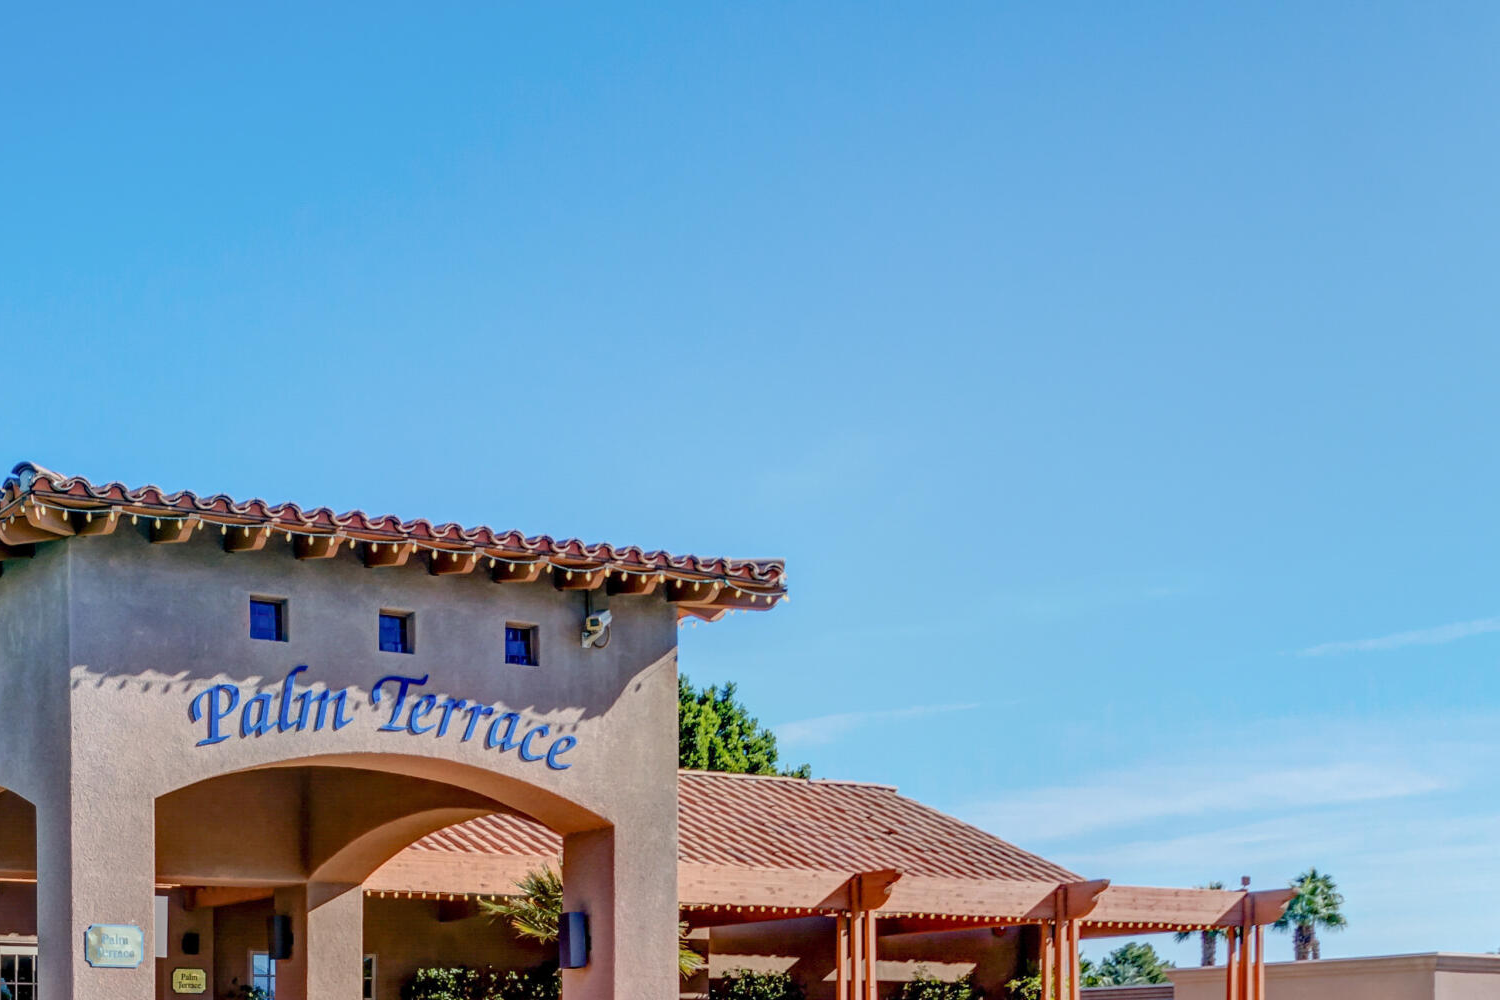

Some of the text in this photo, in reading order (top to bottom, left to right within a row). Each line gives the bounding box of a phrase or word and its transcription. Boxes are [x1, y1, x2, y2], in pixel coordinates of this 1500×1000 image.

[189, 665, 579, 771] Palm Terrace
[101, 934, 129, 945] Palm
[181, 973, 197, 981] Palm
[178, 981, 203, 989] Terrace
